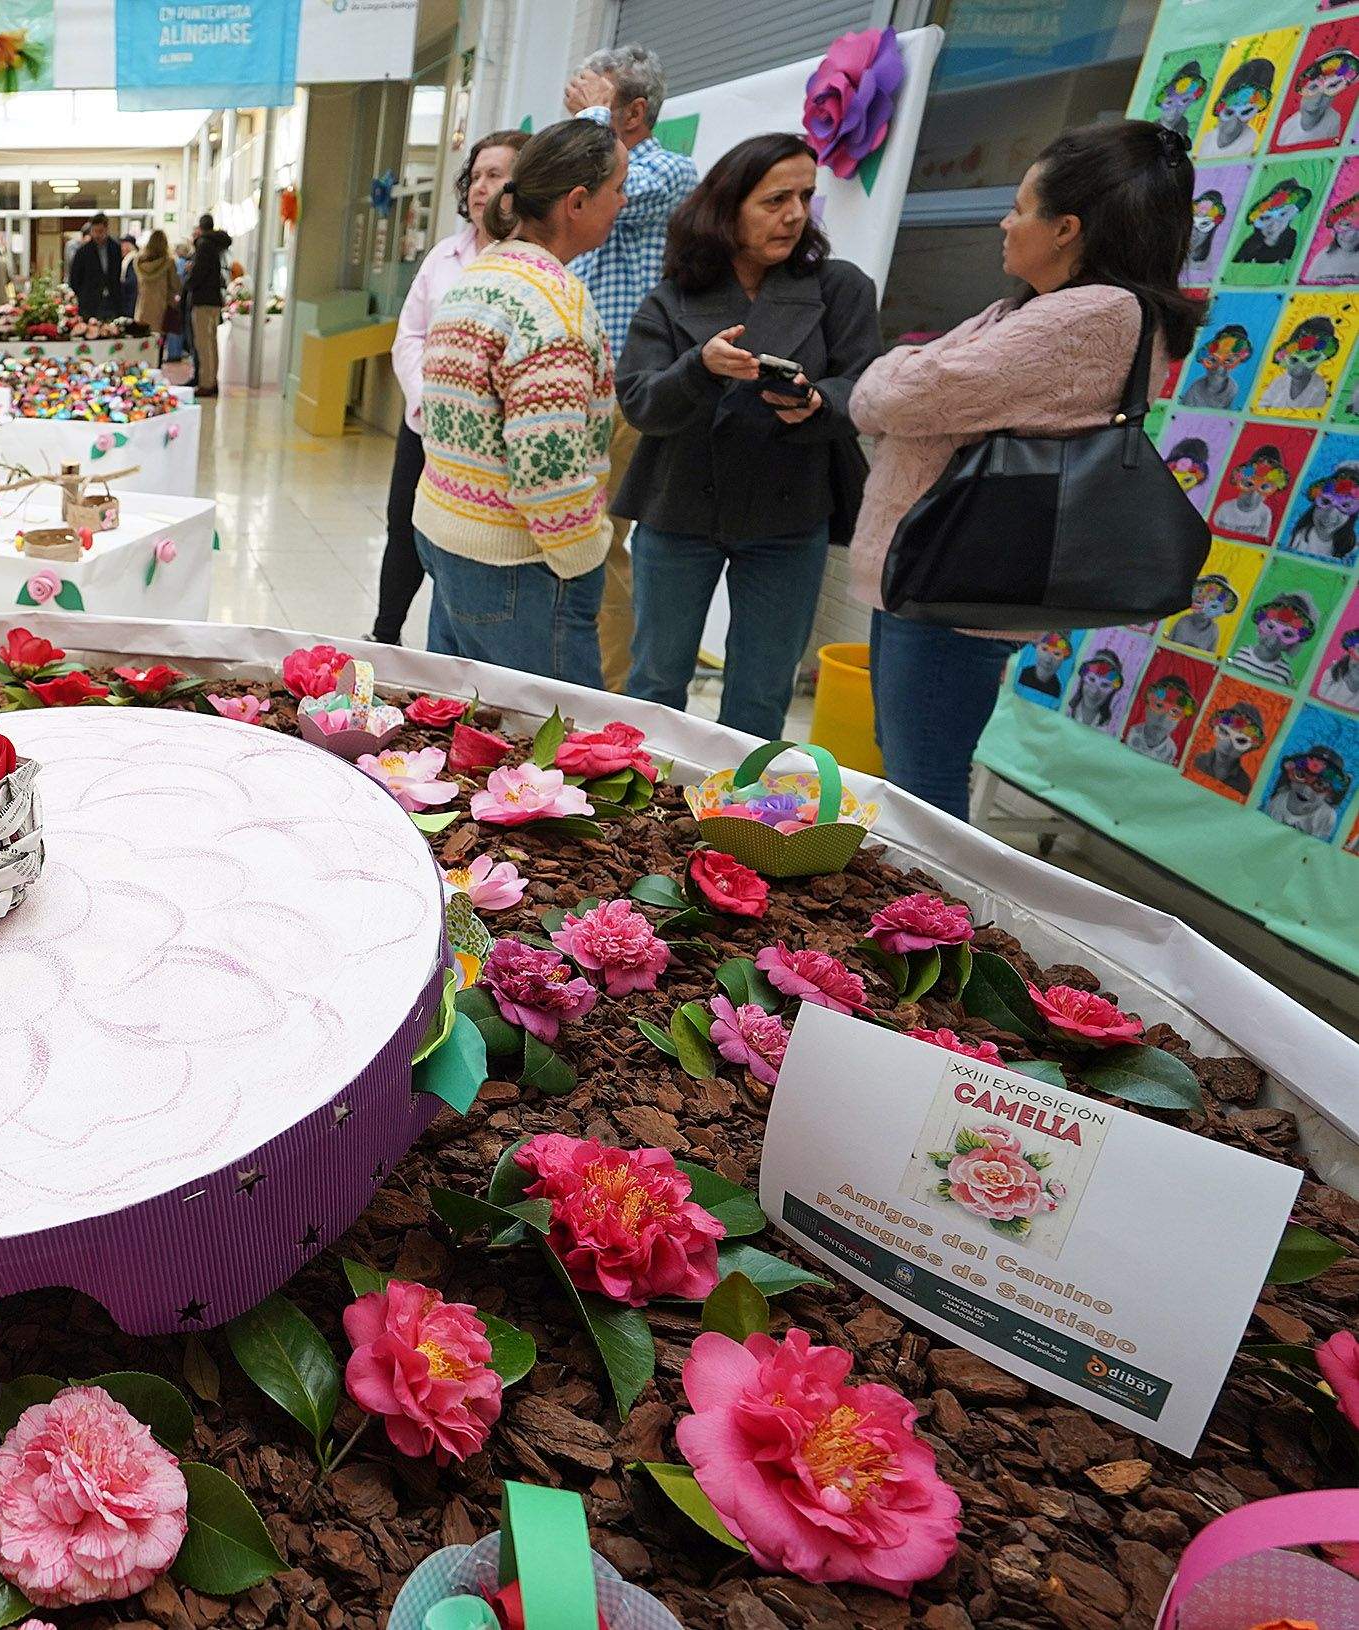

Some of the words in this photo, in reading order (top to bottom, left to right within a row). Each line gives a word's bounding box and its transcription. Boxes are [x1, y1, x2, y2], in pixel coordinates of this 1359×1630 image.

[951, 1063, 989, 1084] XXIII
[992, 1078, 1107, 1126] EXPOSICIÓN
[954, 1082, 1082, 1147] CAMELIA
[817, 1230, 872, 1268] PONTEVEDRA
[837, 1183, 934, 1237] Amigos
[942, 1233, 988, 1261] del
[996, 1254, 1113, 1315] Camino
[816, 1192, 943, 1267] Portugués
[951, 1264, 988, 1287] de
[996, 1281, 1137, 1354] Santiago
[942, 1303, 985, 1328] CAMPOLONGO
[947, 1300, 960, 1310] SAN
[974, 1313, 984, 1321] DE
[1012, 1335, 1022, 1343] de
[1022, 1340, 1067, 1364] Campolongo
[1016, 1328, 1036, 1341] ANPA
[1036, 1337, 1051, 1348] San
